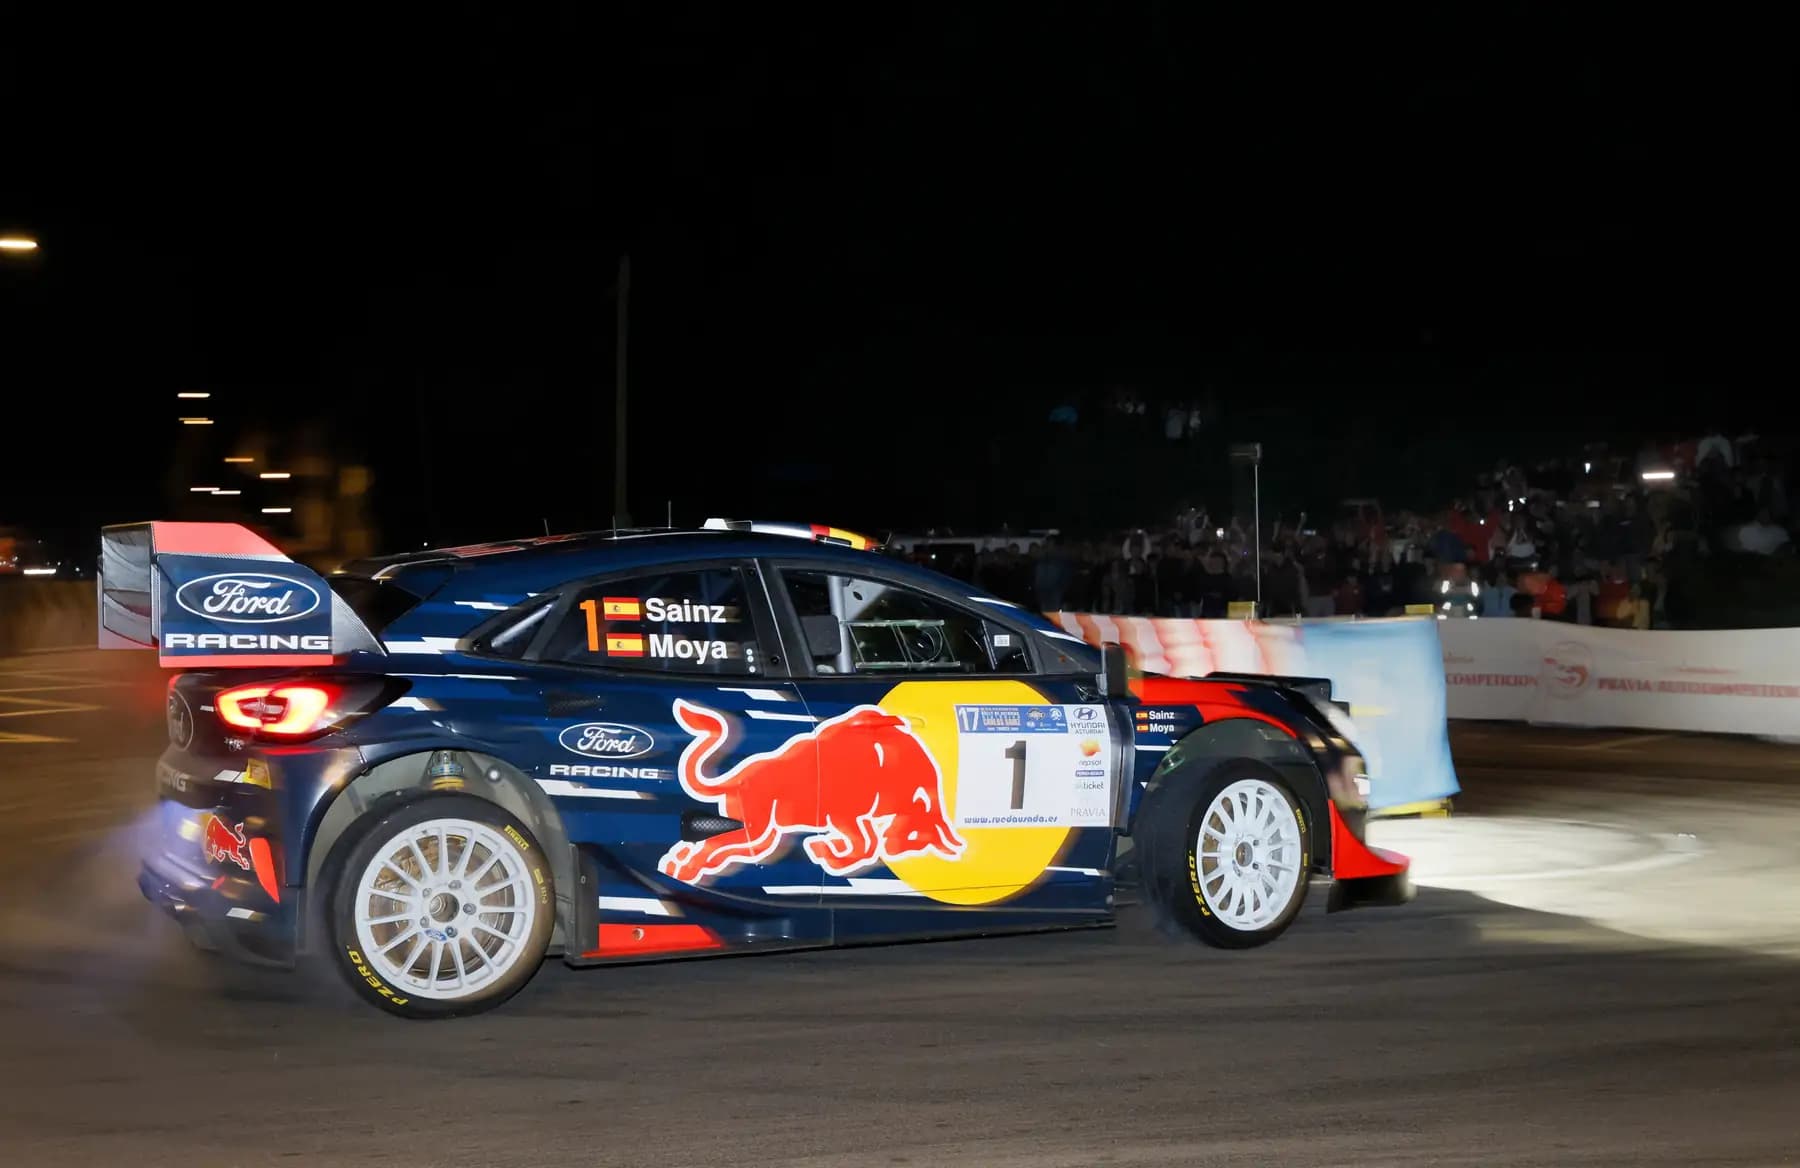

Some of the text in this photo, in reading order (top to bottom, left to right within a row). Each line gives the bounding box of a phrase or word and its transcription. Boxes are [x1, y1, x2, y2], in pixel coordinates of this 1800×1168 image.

[203, 577, 293, 616] Ford
[646, 597, 727, 623] Sainz
[579, 599, 599, 652] 1
[165, 633, 330, 650] RACING
[649, 633, 728, 664] Moya
[958, 706, 980, 732] 17
[1070, 721, 1106, 730] HYUNDAI
[1149, 710, 1175, 720] Sainz
[1149, 723, 1175, 733] Moya
[577, 726, 636, 753] Ford
[550, 764, 659, 780] RACING
[1004, 740, 1027, 810] 1
[348, 949, 409, 1006] P ZERO
